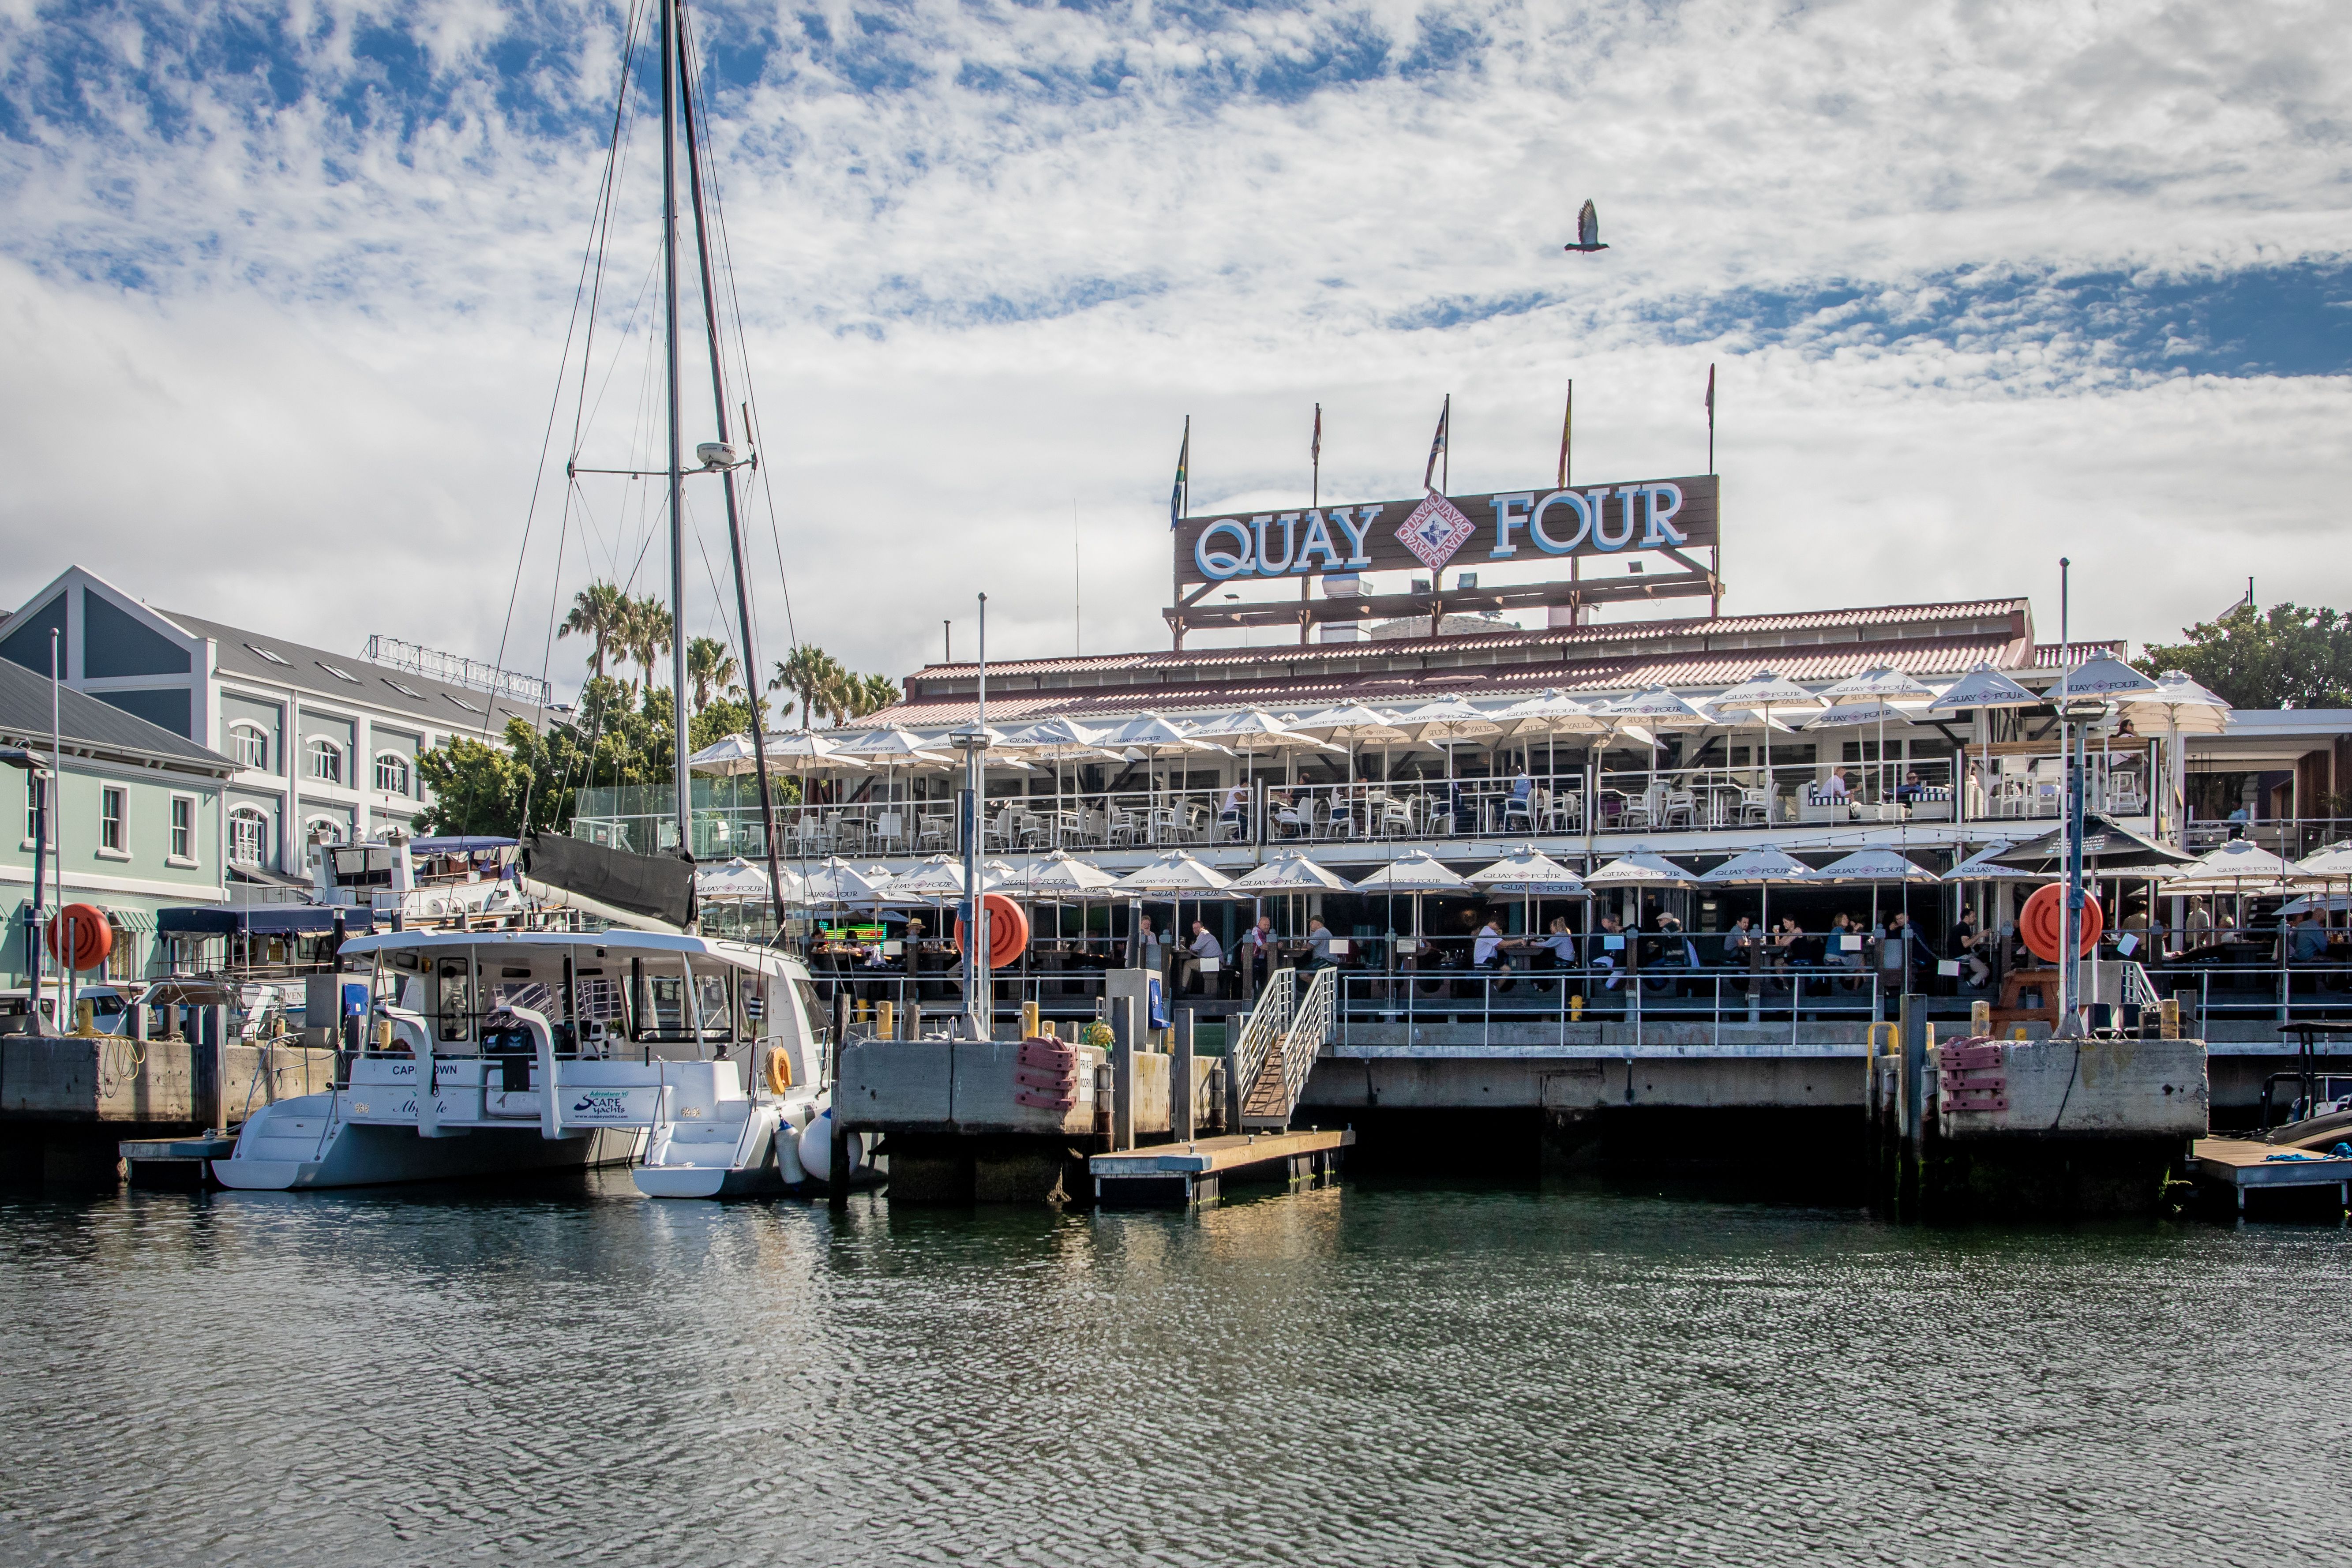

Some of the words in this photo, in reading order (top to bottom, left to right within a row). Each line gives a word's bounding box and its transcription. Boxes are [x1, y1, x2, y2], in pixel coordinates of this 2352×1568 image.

[1399, 502, 1433, 540] QUAY4
[1429, 494, 1463, 529] QUAY4
[1195, 505, 1383, 580] QUAY
[1489, 483, 1687, 557] FOUR
[1436, 523, 1471, 560] QUAY4
[1407, 533, 1440, 569] QUAY4
[382, 643, 441, 670] VICTORIA
[445, 660, 454, 673] &
[458, 663, 504, 687] ALFRED
[508, 675, 545, 698] HOTEL
[2109, 680, 2139, 689] FOUR
[1864, 709, 1892, 719] FOUR
[392, 1065, 416, 1075] CAP
[1080, 1060, 1092, 1069] PRIVATE
[574, 1094, 621, 1111] SCAPE
[593, 1105, 625, 1114] yachts
